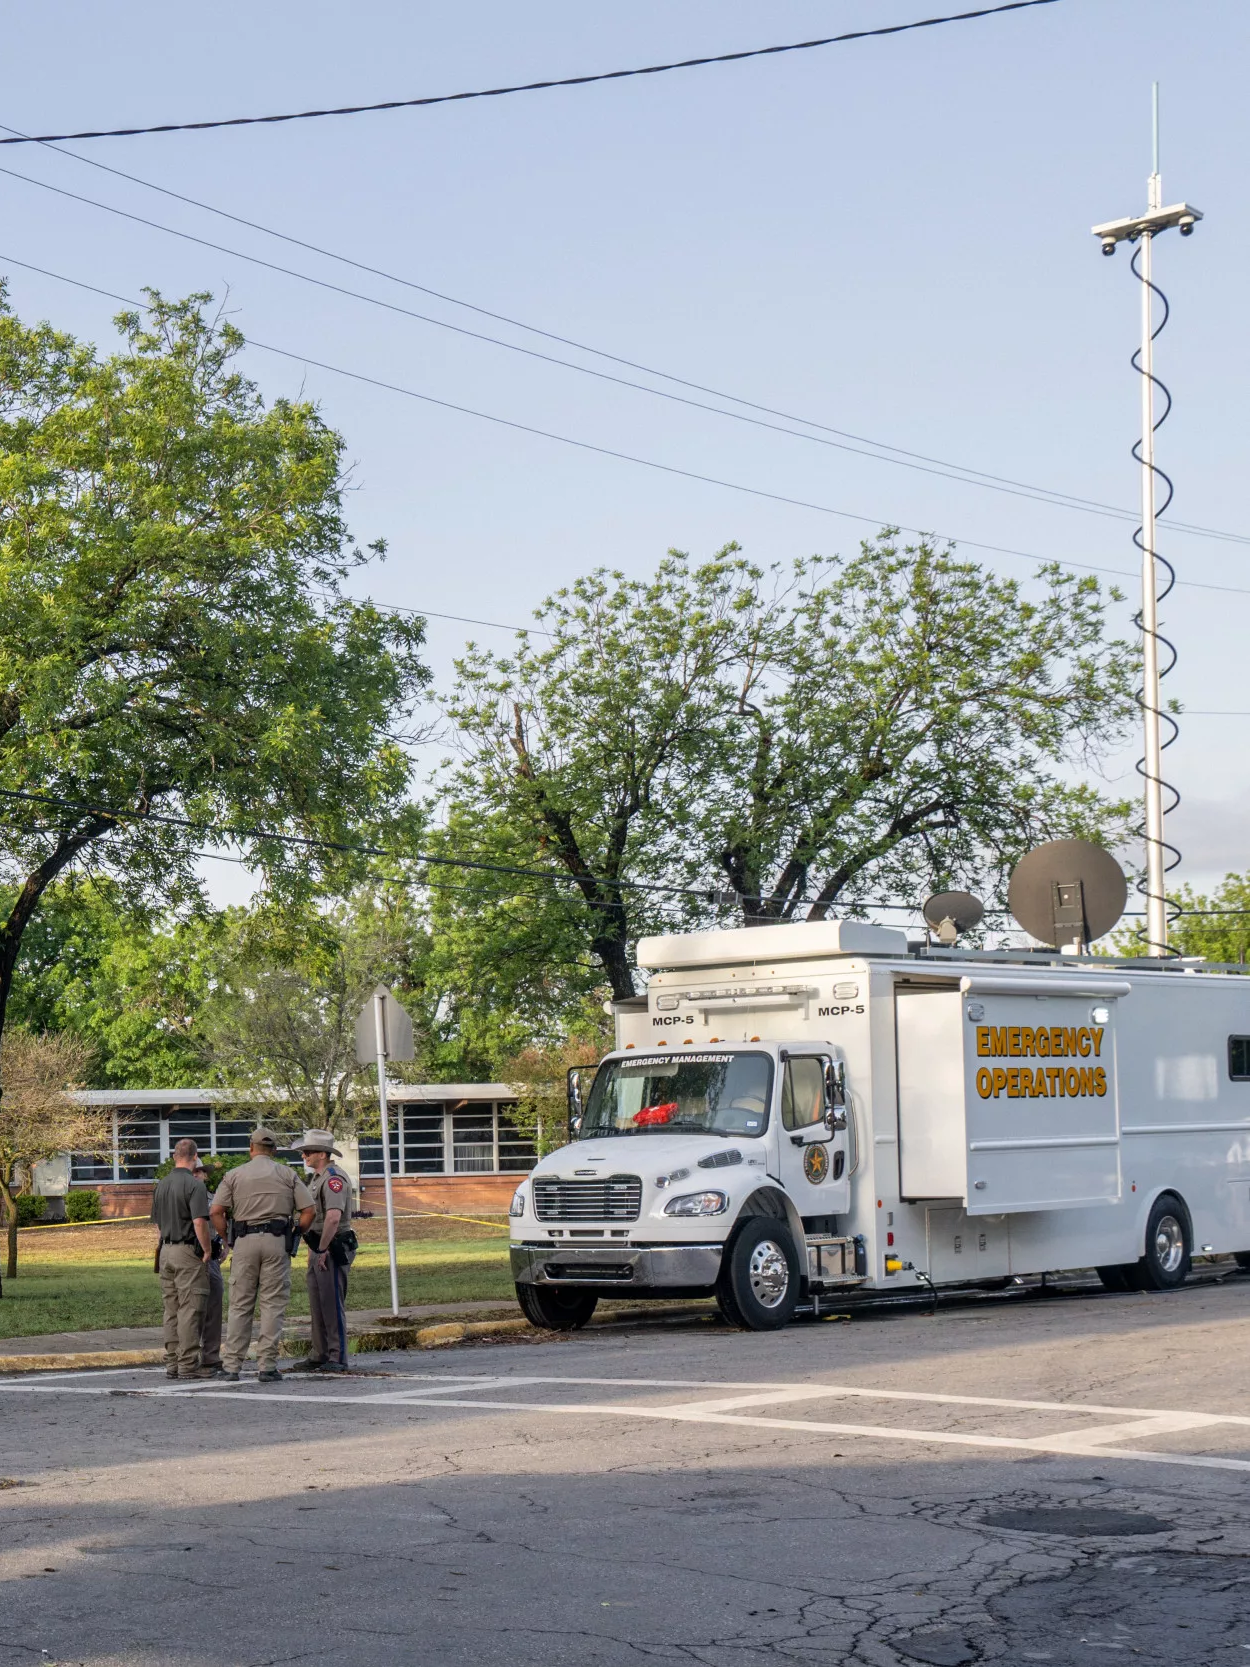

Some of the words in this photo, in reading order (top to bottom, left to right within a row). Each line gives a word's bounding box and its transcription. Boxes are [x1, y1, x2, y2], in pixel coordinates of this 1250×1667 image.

[818, 1005, 865, 1017] MCP-5
[652, 1015, 695, 1027] MCP-5
[976, 1026, 1104, 1057] EMERGENCY
[621, 1056, 670, 1068] EMERGENCY
[671, 1055, 734, 1064] MANAGEMENT
[976, 1067, 1107, 1099] OPERATIONS
